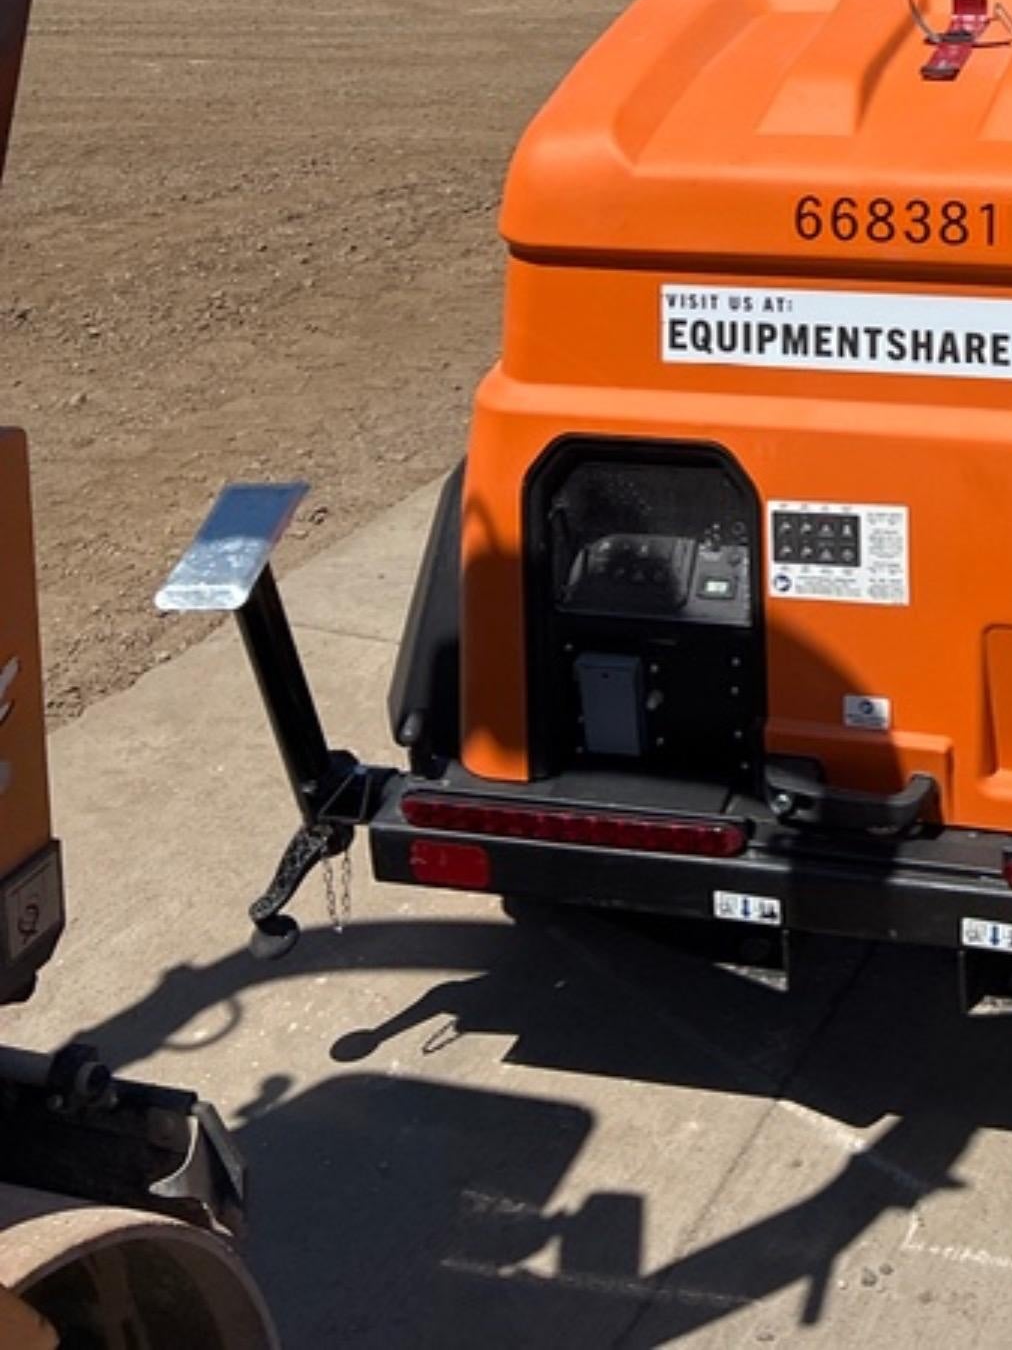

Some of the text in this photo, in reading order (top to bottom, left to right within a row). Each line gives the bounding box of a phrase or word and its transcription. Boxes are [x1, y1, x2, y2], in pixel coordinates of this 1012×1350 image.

[794, 195, 998, 246] 668381
[666, 293, 793, 313] VISIT US AT:
